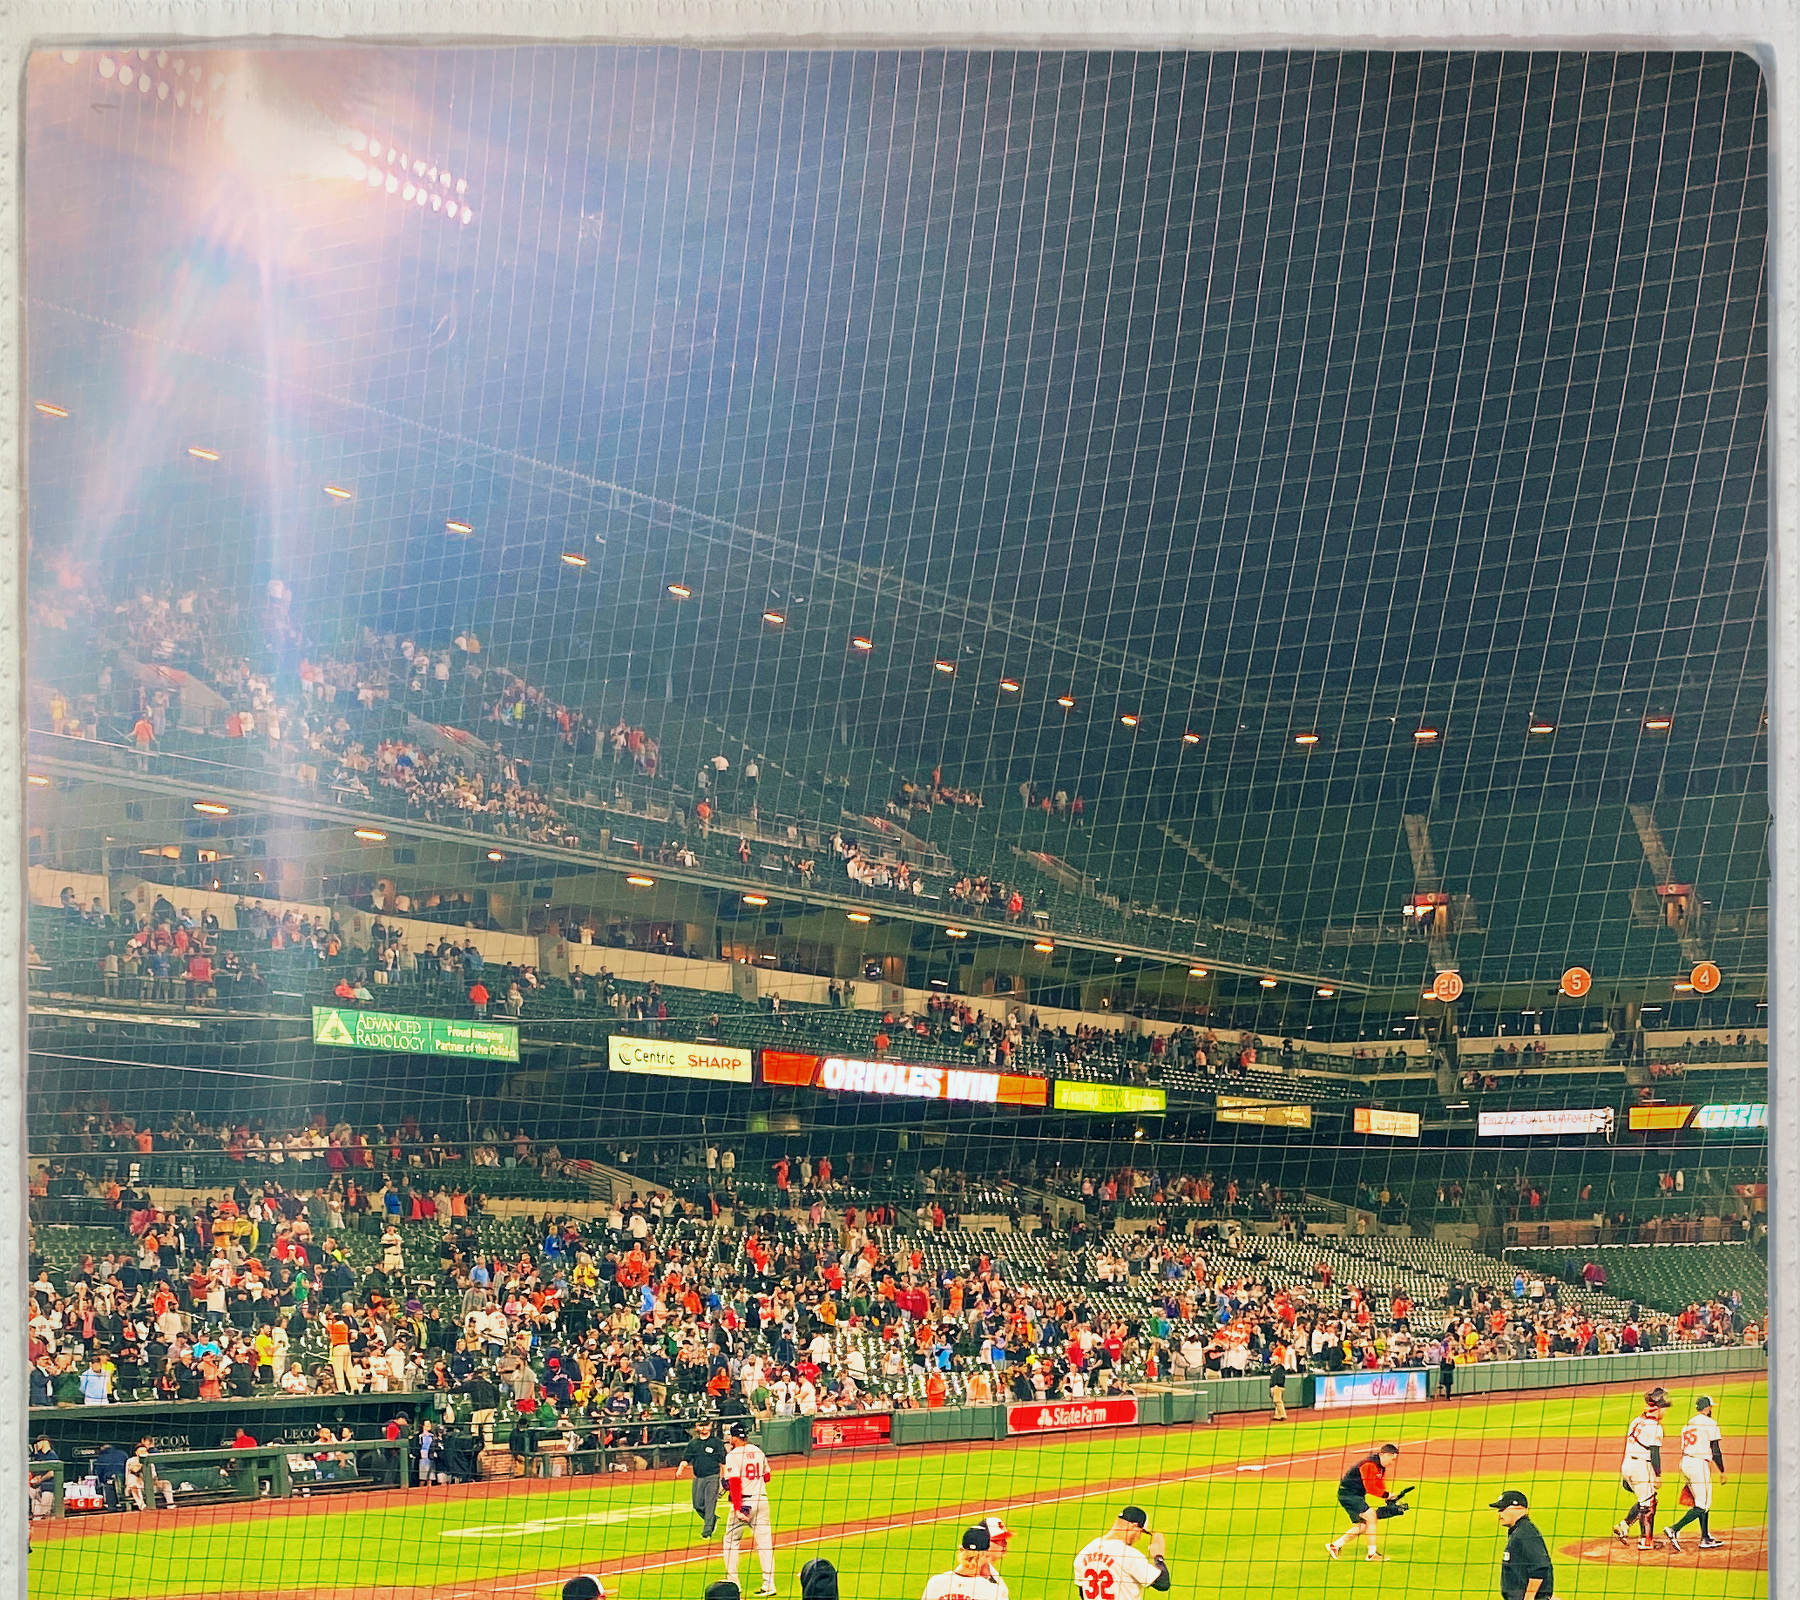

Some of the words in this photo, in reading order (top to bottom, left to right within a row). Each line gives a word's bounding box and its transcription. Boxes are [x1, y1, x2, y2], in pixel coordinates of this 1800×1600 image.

[1438, 979, 1459, 995] 20
[1571, 974, 1582, 991] 5
[1699, 970, 1711, 986] 4
[356, 1012, 421, 1034] ADVANCED
[356, 1028, 425, 1051] RADIOLOGY
[447, 1026, 471, 1038] Proud
[472, 1028, 504, 1044] Imaging
[435, 1039, 464, 1053] Partner
[475, 1043, 488, 1055] the
[489, 1044, 516, 1058] Orioles
[634, 1048, 675, 1066] Centric
[688, 1054, 742, 1070] SHARP
[824, 1058, 943, 1098] ORIOLES
[947, 1070, 1000, 1102] WIN
[1371, 1379, 1397, 1397] Chill
[151, 1434, 190, 1447] ECOM
[284, 1428, 317, 1439] LECO
[745, 1462, 760, 1481] 81
[1084, 1568, 1116, 1600] 32
